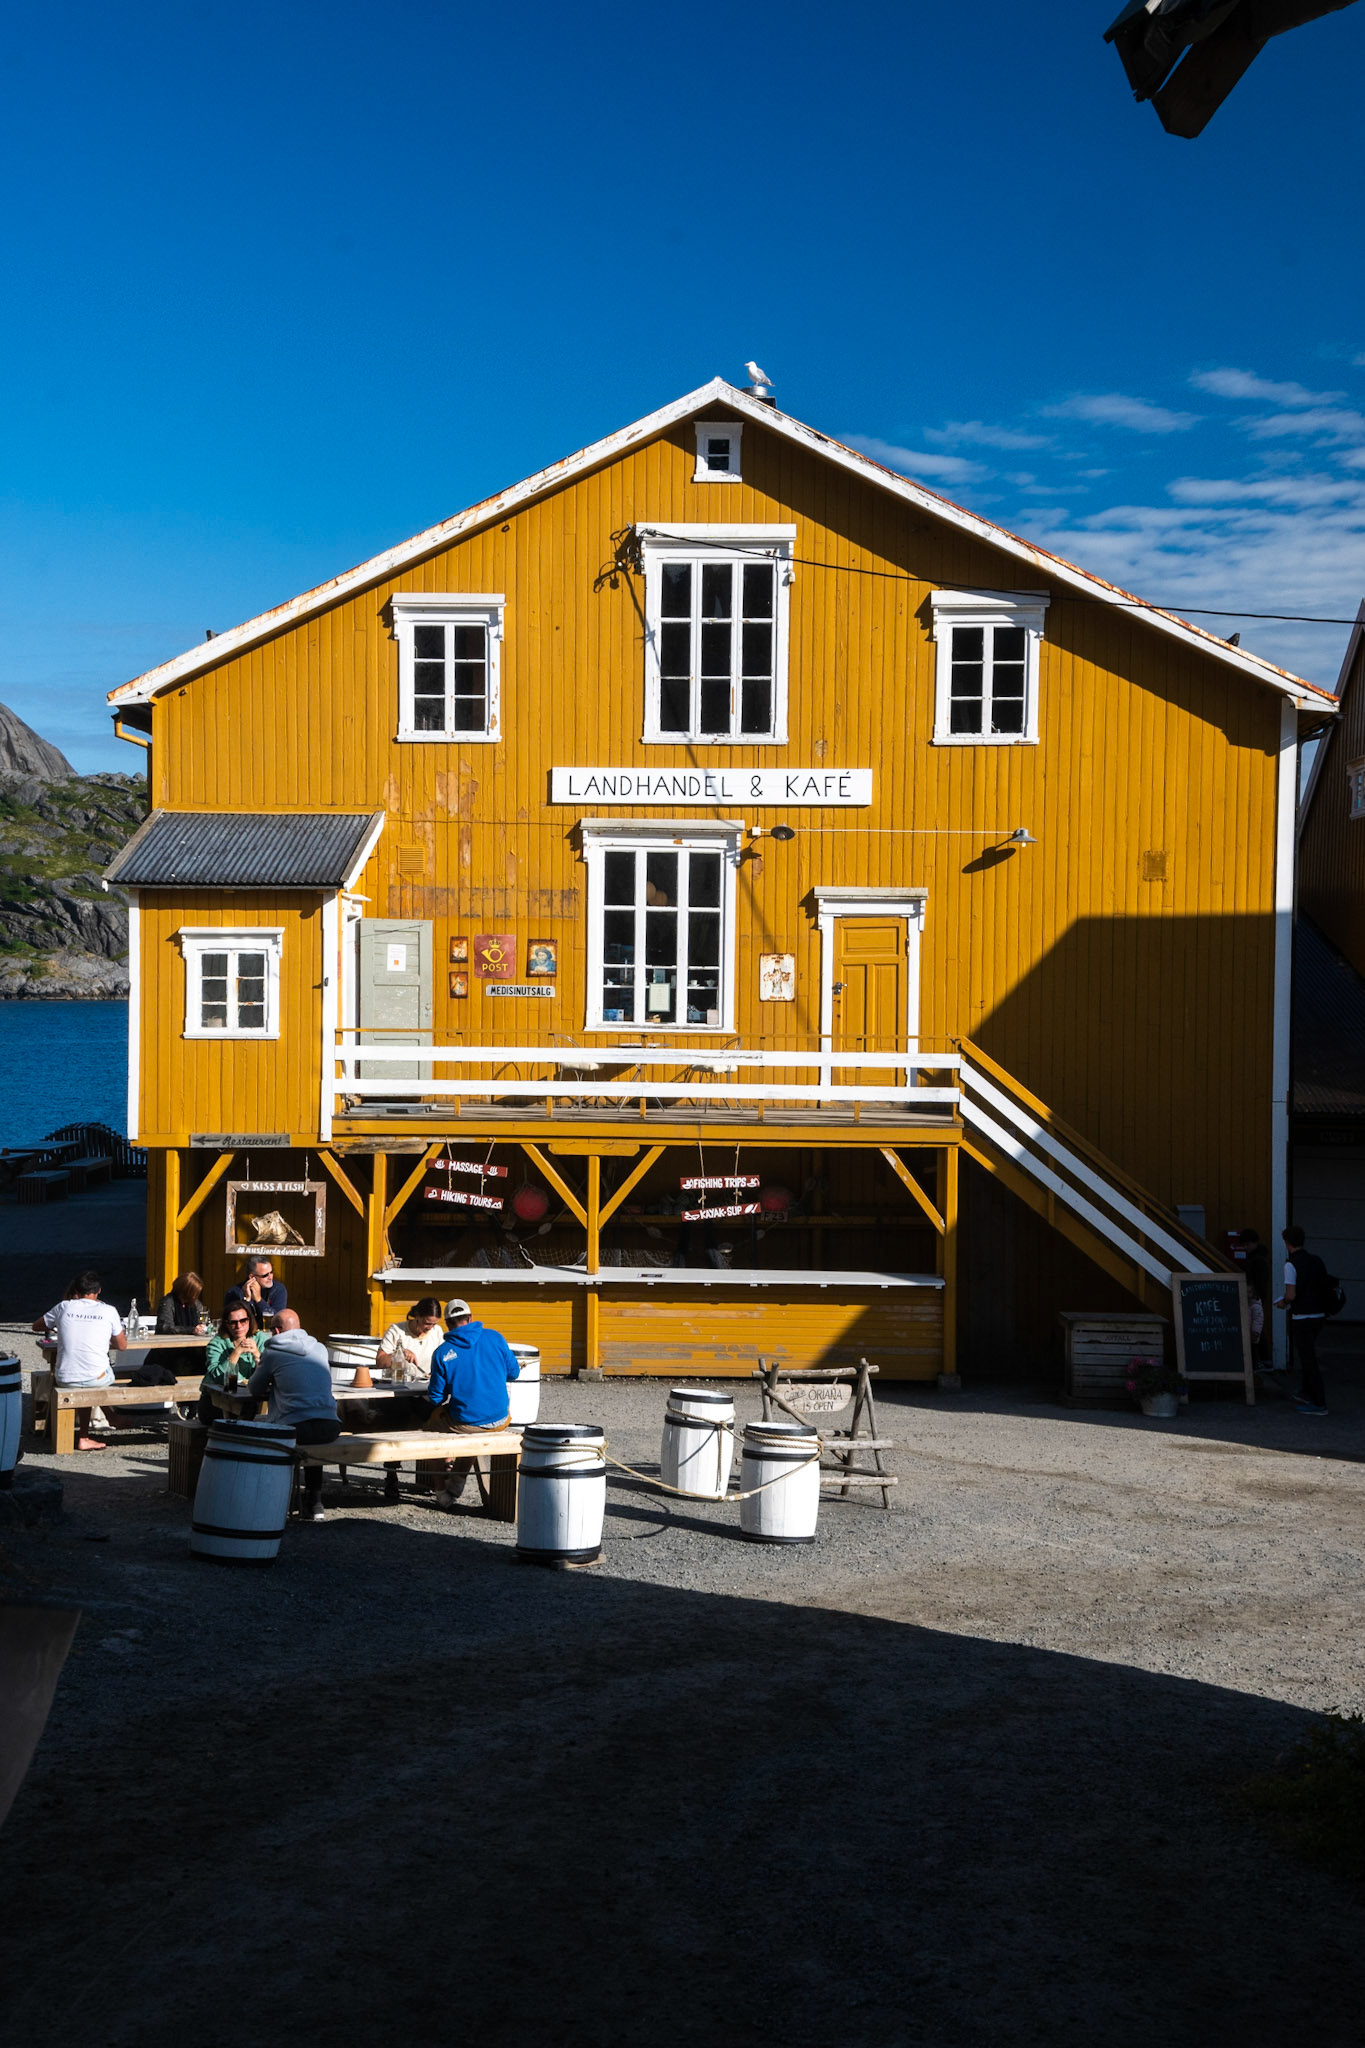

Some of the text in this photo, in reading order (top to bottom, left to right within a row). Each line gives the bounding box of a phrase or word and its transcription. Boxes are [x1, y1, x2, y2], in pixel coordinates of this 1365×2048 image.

[568, 771, 852, 798] LANDHANDEL & KAFÉ
[482, 963, 509, 972] POST
[490, 986, 551, 996] MEDISINUTSALG
[222, 1134, 282, 1146] Restaurant
[448, 1161, 484, 1174] MASSAGE
[252, 1183, 274, 1191] KISS
[276, 1183, 283, 1191] A
[694, 1177, 747, 1189] FISHING TRIPS
[440, 1190, 493, 1208] HIKING TOURS
[808, 1389, 843, 1400] ORIANA
[802, 1402, 833, 1411] IS OPEN
